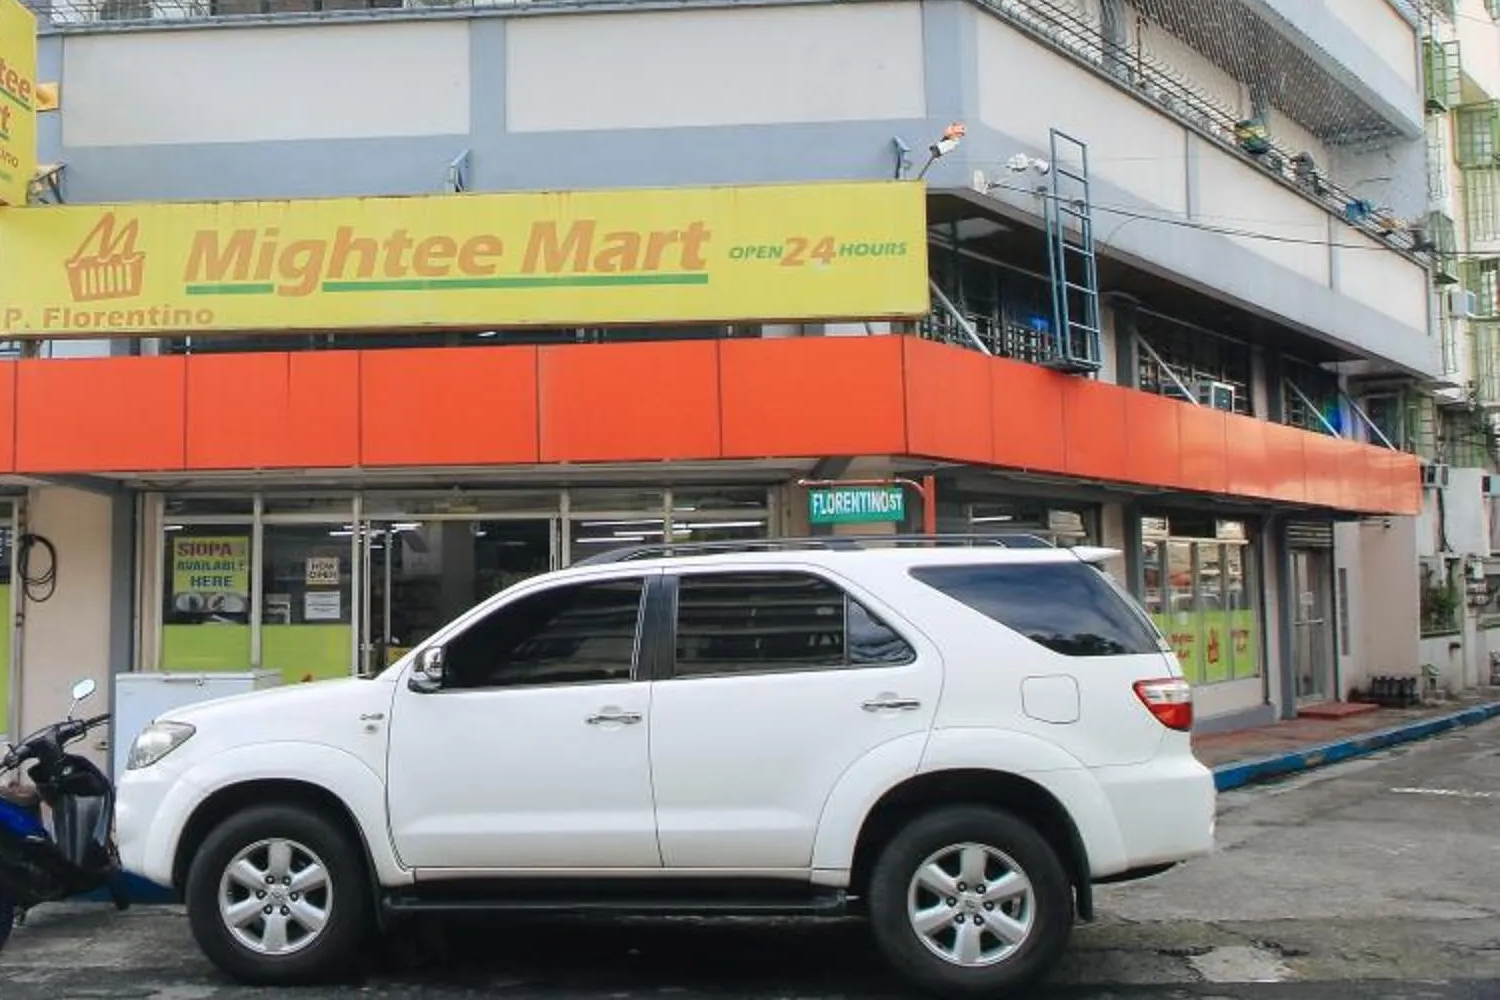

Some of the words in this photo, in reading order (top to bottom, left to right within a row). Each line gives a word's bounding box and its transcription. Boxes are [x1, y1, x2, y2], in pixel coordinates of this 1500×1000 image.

[184, 226, 503, 296] Mightee
[521, 219, 712, 274] Mart
[728, 245, 784, 260] OPEN
[780, 236, 837, 267] 24
[838, 242, 908, 257] HOURS
[4, 307, 31, 329] P.
[43, 303, 215, 328] Florentino
[812, 490, 888, 515] FLORENTINO
[190, 575, 233, 588] HERE
